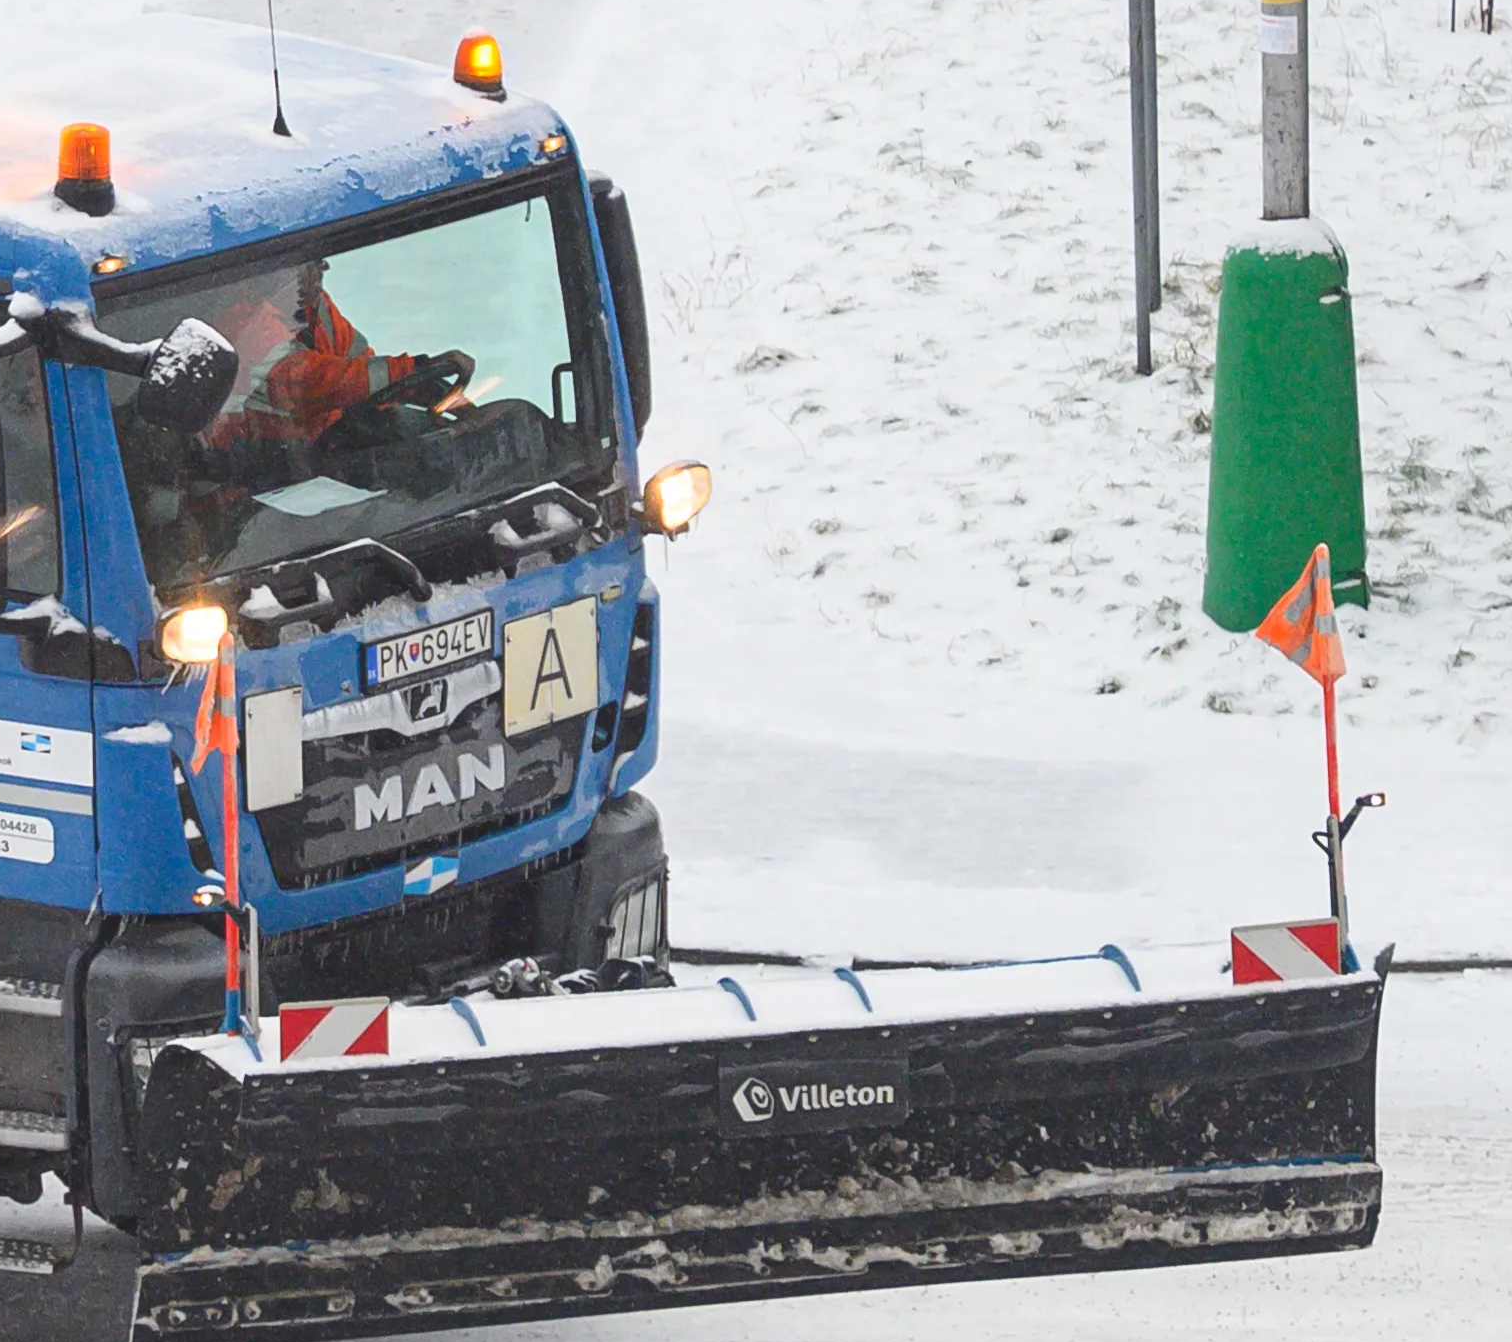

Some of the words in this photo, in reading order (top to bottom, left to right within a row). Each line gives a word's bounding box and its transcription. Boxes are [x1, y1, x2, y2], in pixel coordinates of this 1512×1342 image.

[379, 639, 408, 678] PK
[421, 615, 490, 665] 694EV
[529, 627, 574, 711] A
[354, 743, 506, 830] MAN
[778, 1083, 895, 1112] Villeton
